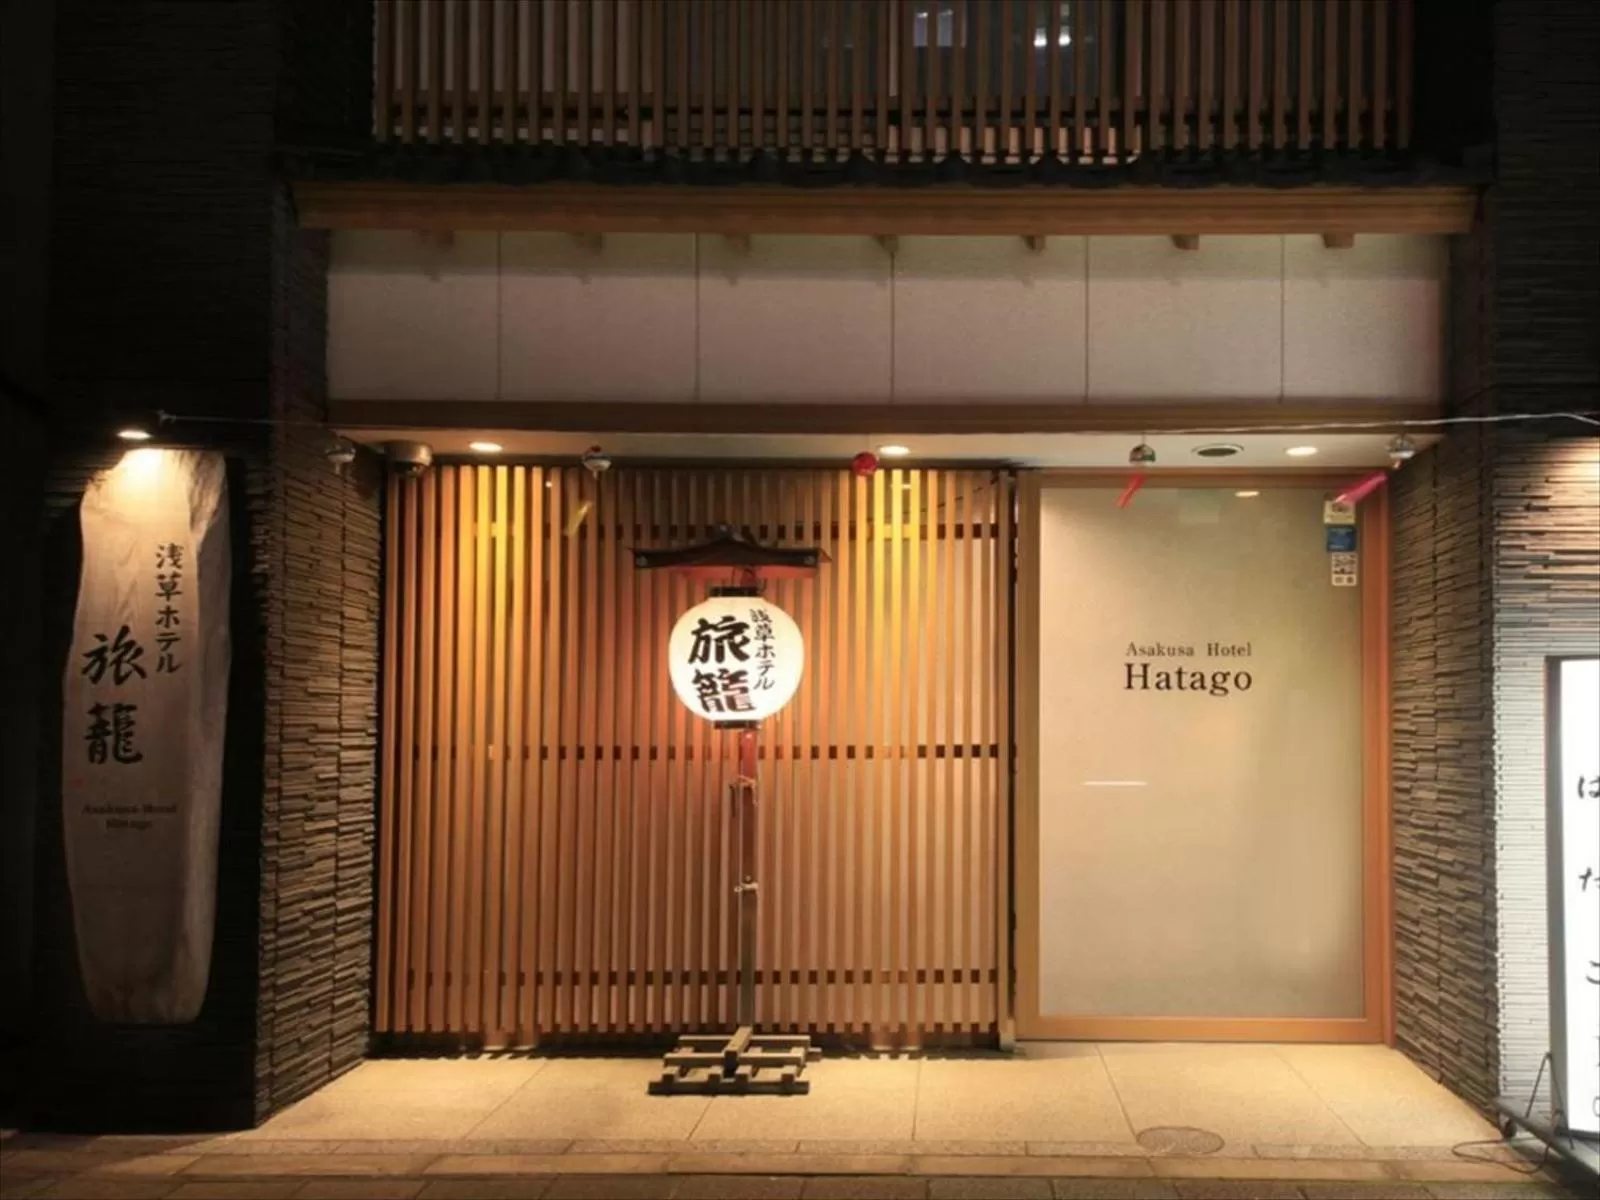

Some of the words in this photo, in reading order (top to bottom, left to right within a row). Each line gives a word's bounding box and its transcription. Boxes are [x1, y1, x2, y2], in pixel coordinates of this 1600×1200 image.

[155, 542, 183, 674] 浅草ホテル
[749, 608, 776, 690] 浅草ホテル
[1125, 641, 1195, 657] Asakusa
[1206, 641, 1252, 657] Hotel
[687, 615, 756, 714] 旅籠
[1123, 662, 1252, 697] Hatago
